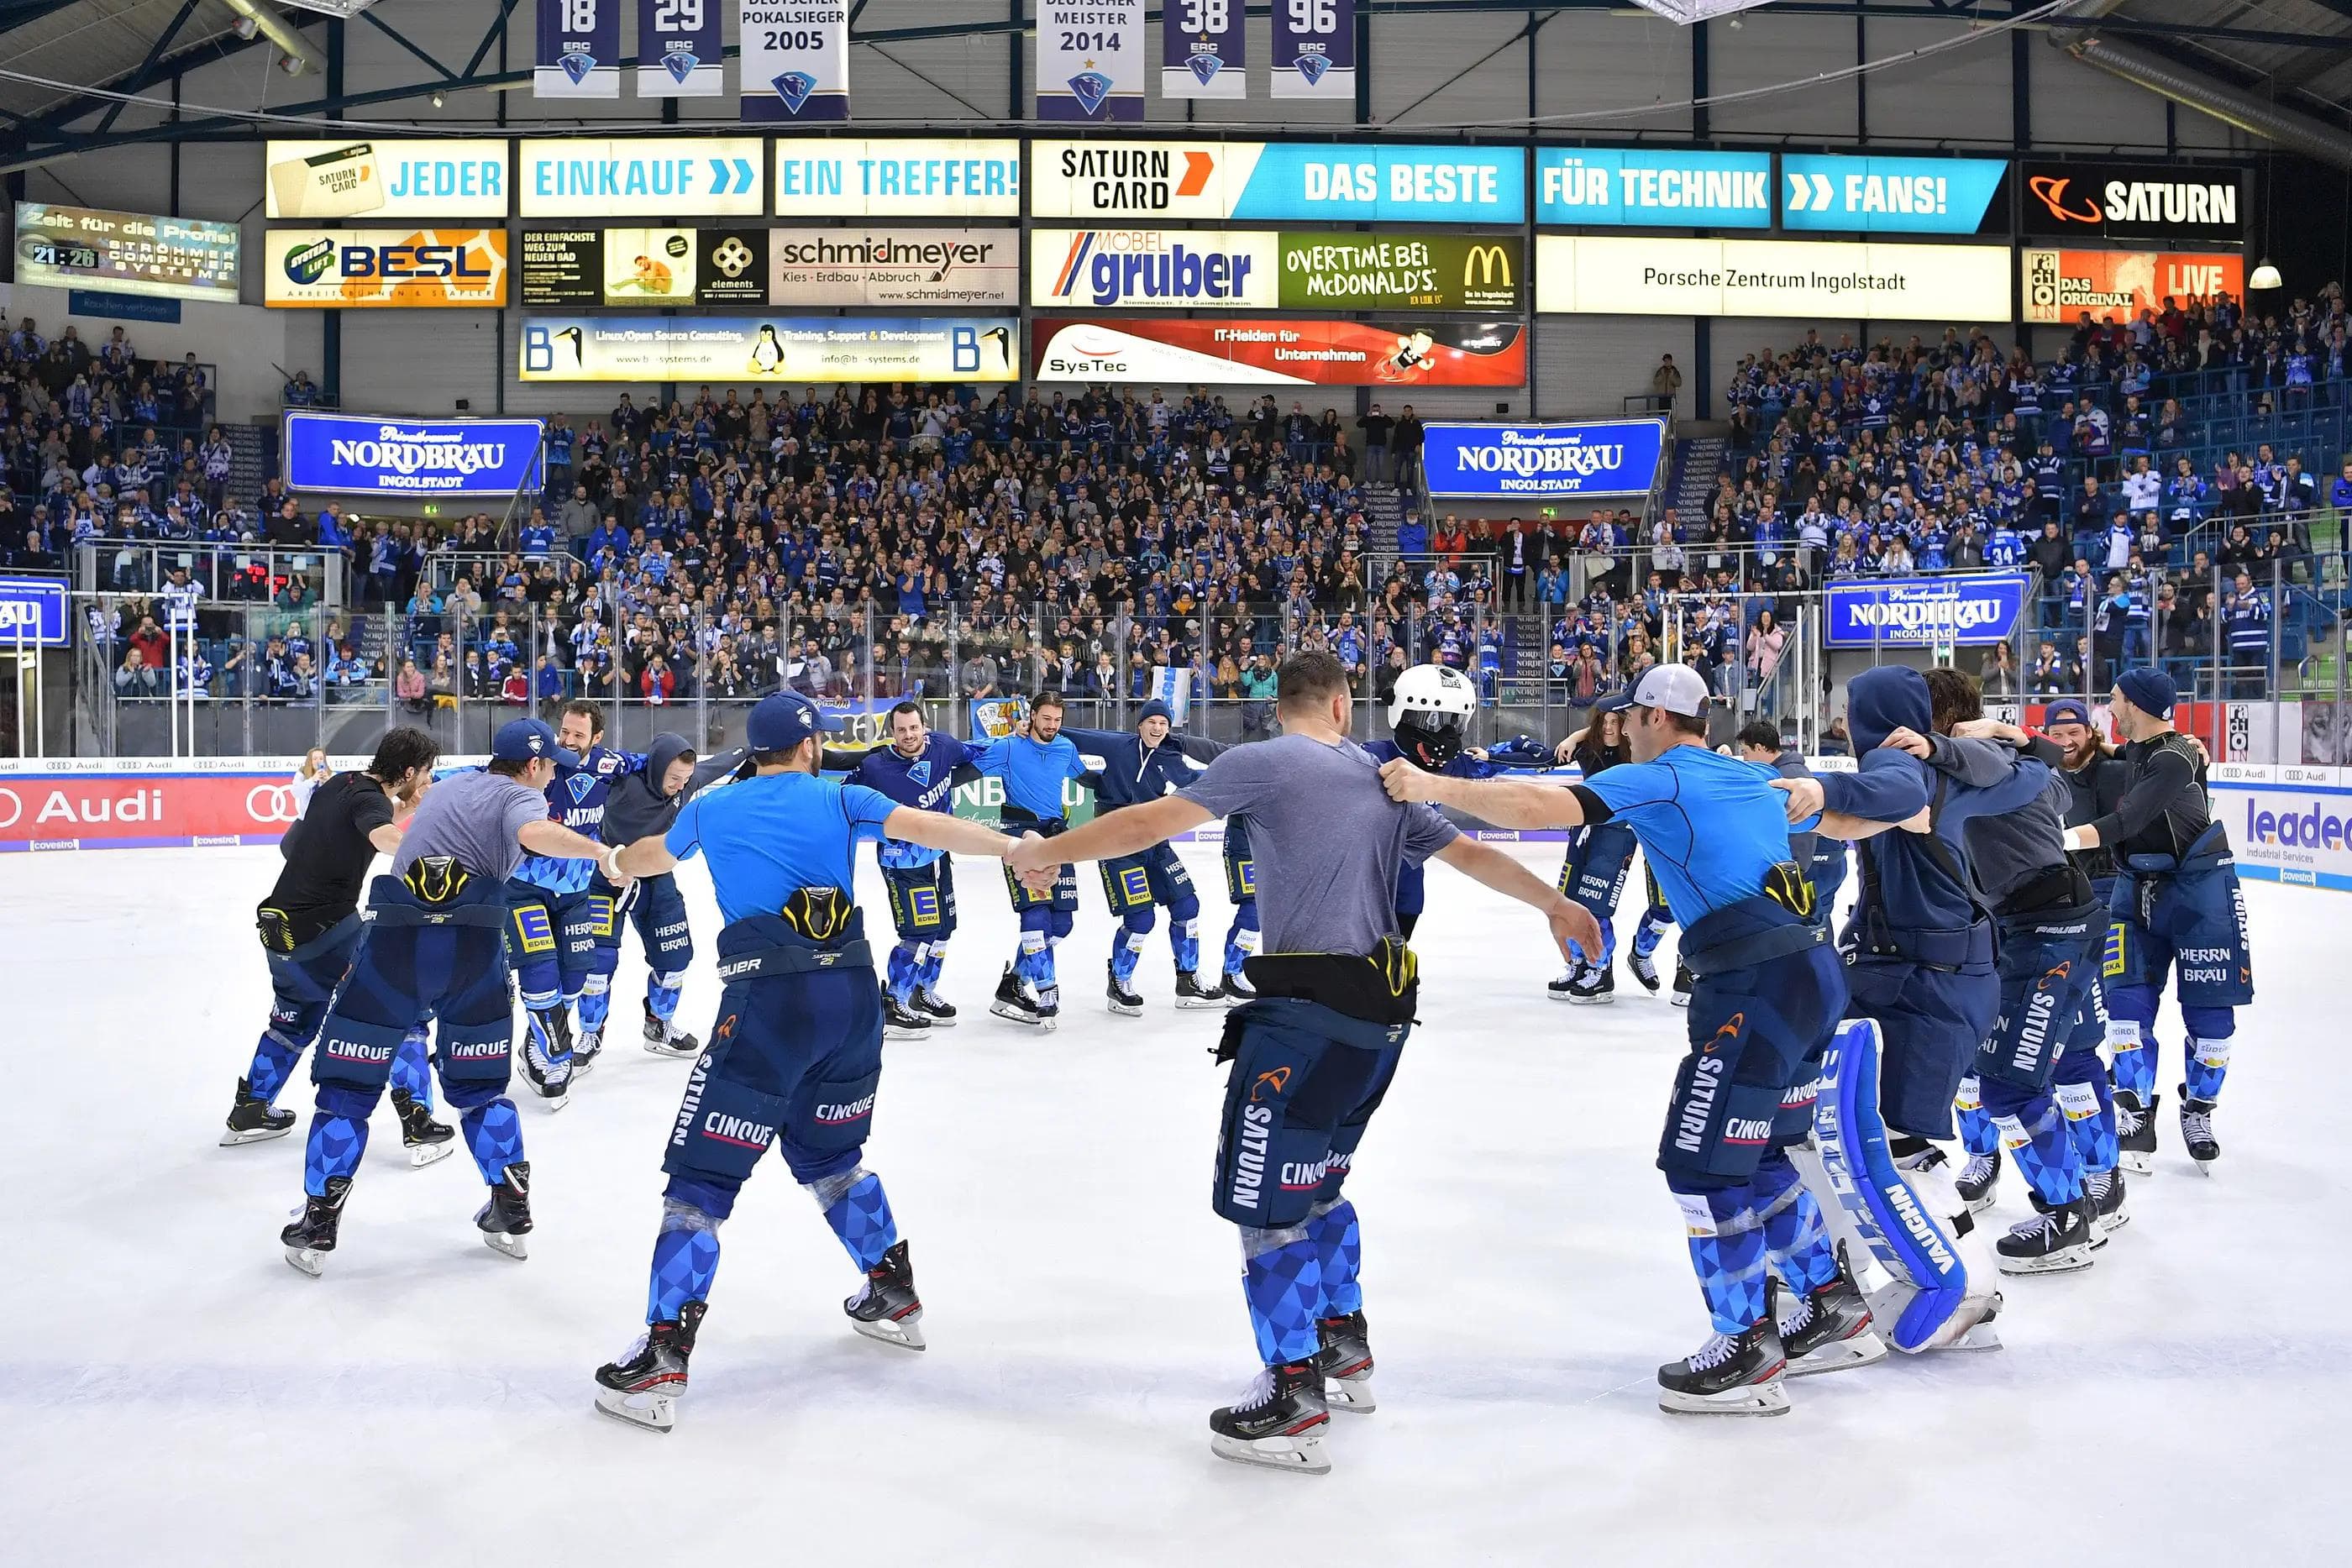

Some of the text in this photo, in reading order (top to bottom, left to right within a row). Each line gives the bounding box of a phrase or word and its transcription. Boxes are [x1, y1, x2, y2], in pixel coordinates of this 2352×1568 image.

[560, 0, 596, 33] 18
[655, 0, 703, 32] 29
[743, 11, 845, 24] POKALSIEGER
[1054, 12, 1127, 25] MEISTER
[1180, 0, 1228, 34] 38
[1289, 0, 1337, 34] 96
[764, 31, 824, 50] 2005
[1060, 32, 1121, 51] 2014
[1299, 43, 1326, 51] ERC
[1062, 149, 1169, 179] SATURN
[319, 168, 357, 185] SATURN
[391, 162, 501, 197] JEDER
[536, 159, 694, 197] EINKAUF
[784, 160, 1018, 196] EIN TREFFER!
[1304, 163, 1498, 203] DAS BESTE
[1543, 156, 1768, 209] FÜR TECHNIK
[331, 178, 357, 194] CARD
[1093, 181, 1169, 210] CARD
[1845, 175, 1947, 216] FANS!
[2104, 181, 2236, 223] SATURN
[24, 211, 74, 228] Zeit
[80, 216, 116, 233] für
[123, 221, 156, 237] die
[523, 232, 596, 243] DER EINFACHSTE
[1097, 232, 1168, 252] MÖBEL
[34, 245, 96, 267] 21:26
[108, 239, 235, 260] STRÖHMER
[290, 241, 329, 269] SYSTEM
[523, 242, 566, 252] WEG ZUM
[784, 237, 994, 274] schmidmeyer
[108, 250, 235, 271] COMPUTER
[308, 255, 330, 273] LIFT
[340, 246, 491, 277] BESL
[523, 252, 576, 262] NEUEN BAD
[115, 261, 228, 281] SYSTEME
[783, 271, 921, 283] Kies Erdbau Abbruch
[1092, 244, 1252, 306] gruber
[2168, 263, 2223, 296] LIVE
[711, 280, 754, 289] elements
[1643, 265, 1907, 296] Porsche Zentrum Ingolstadt
[2060, 278, 2092, 292] DAS
[287, 288, 405, 297] ARBEITSBÜHNEN
[433, 289, 492, 297] STAPLER
[879, 289, 1005, 302] www.schmidmeyer.net
[2060, 292, 2134, 307] ORIGINAL
[654, 330, 689, 342] Source
[827, 330, 867, 343] Support
[869, 331, 878, 342] &
[879, 330, 946, 343] Development
[1214, 328, 1301, 343] IT-Helden für
[616, 355, 712, 364] www.b-systems.de
[821, 354, 921, 365] info@b-systems.de
[1274, 349, 1367, 362] Unternehmen
[1050, 359, 1127, 375] SysTec
[331, 439, 506, 475] NORDBRÄU
[1457, 444, 1624, 476] NORDBRÄU
[379, 475, 464, 488] INGOLSTADT
[1500, 479, 1582, 490] INGOLSTADT
[1992, 546, 2013, 566] 34
[76, 760, 102, 769] Audi
[146, 760, 172, 768] Audi
[219, 760, 245, 768] Audi
[600, 762, 613, 770] DEL
[2244, 769, 2266, 779] Audi
[2306, 771, 2326, 781] Audi
[35, 789, 162, 824] Audi
[197, 836, 235, 845] covestro
[1481, 831, 1515, 839] covestro
[34, 839, 75, 850] covestro
[2246, 847, 2314, 863] Industrial Services
[1582, 874, 1609, 889] HERRN
[2283, 870, 2313, 882] covestro
[1608, 868, 1627, 908] SATURN
[654, 920, 688, 938] HERRN
[2034, 923, 2087, 935] BAUER
[2179, 947, 2231, 963] HERRN
[2183, 967, 2227, 983] BRÄU
[2012, 992, 2055, 1072] SATURN
[327, 1039, 393, 1062] CINQUE
[672, 1052, 713, 1147] SATURN
[816, 1093, 875, 1122] CINQUE
[1674, 1056, 1724, 1154] SATURN
[703, 1110, 774, 1146] CINQUE
[1232, 1104, 1273, 1209] SATURN
[1885, 1183, 1956, 1276] VAUGHN
